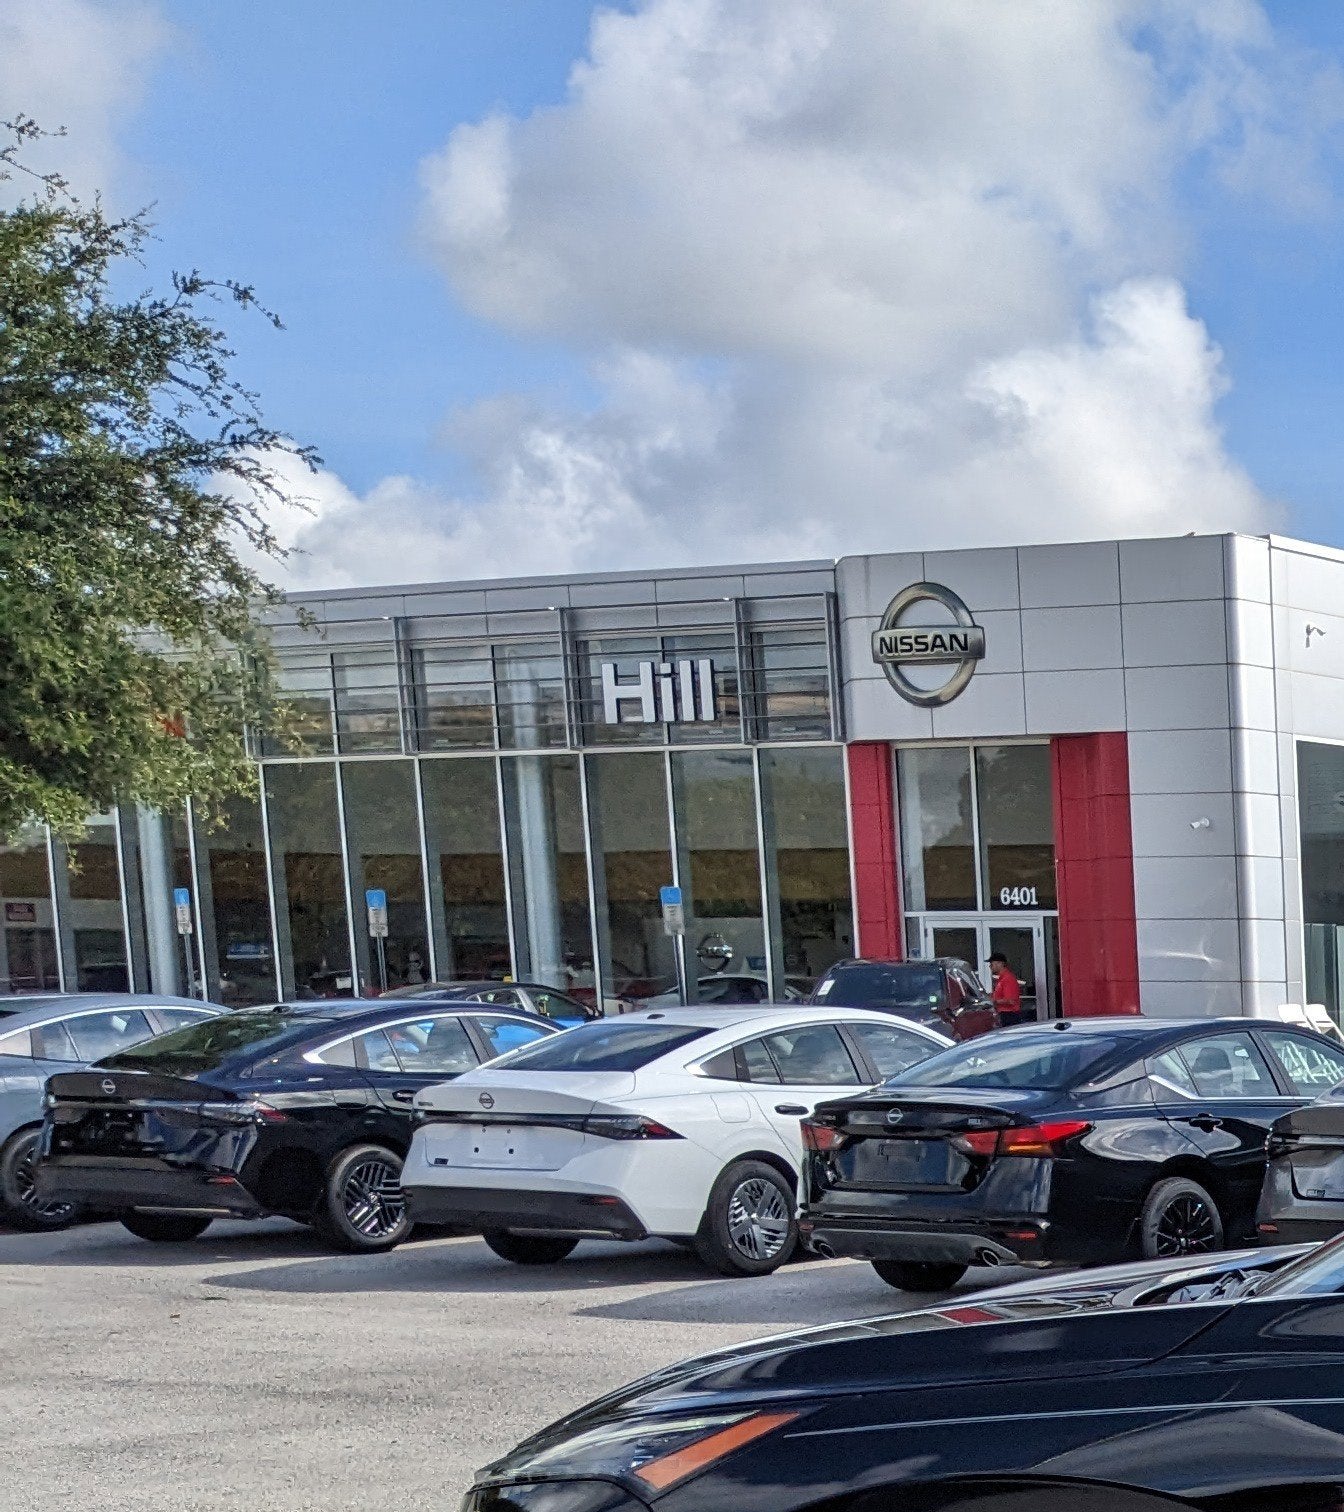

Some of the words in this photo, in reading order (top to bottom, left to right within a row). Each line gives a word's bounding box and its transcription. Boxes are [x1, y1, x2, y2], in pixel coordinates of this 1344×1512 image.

[880, 633, 969, 656] NISSAN
[601, 659, 715, 724] Hill
[1000, 886, 1039, 905] 6401
